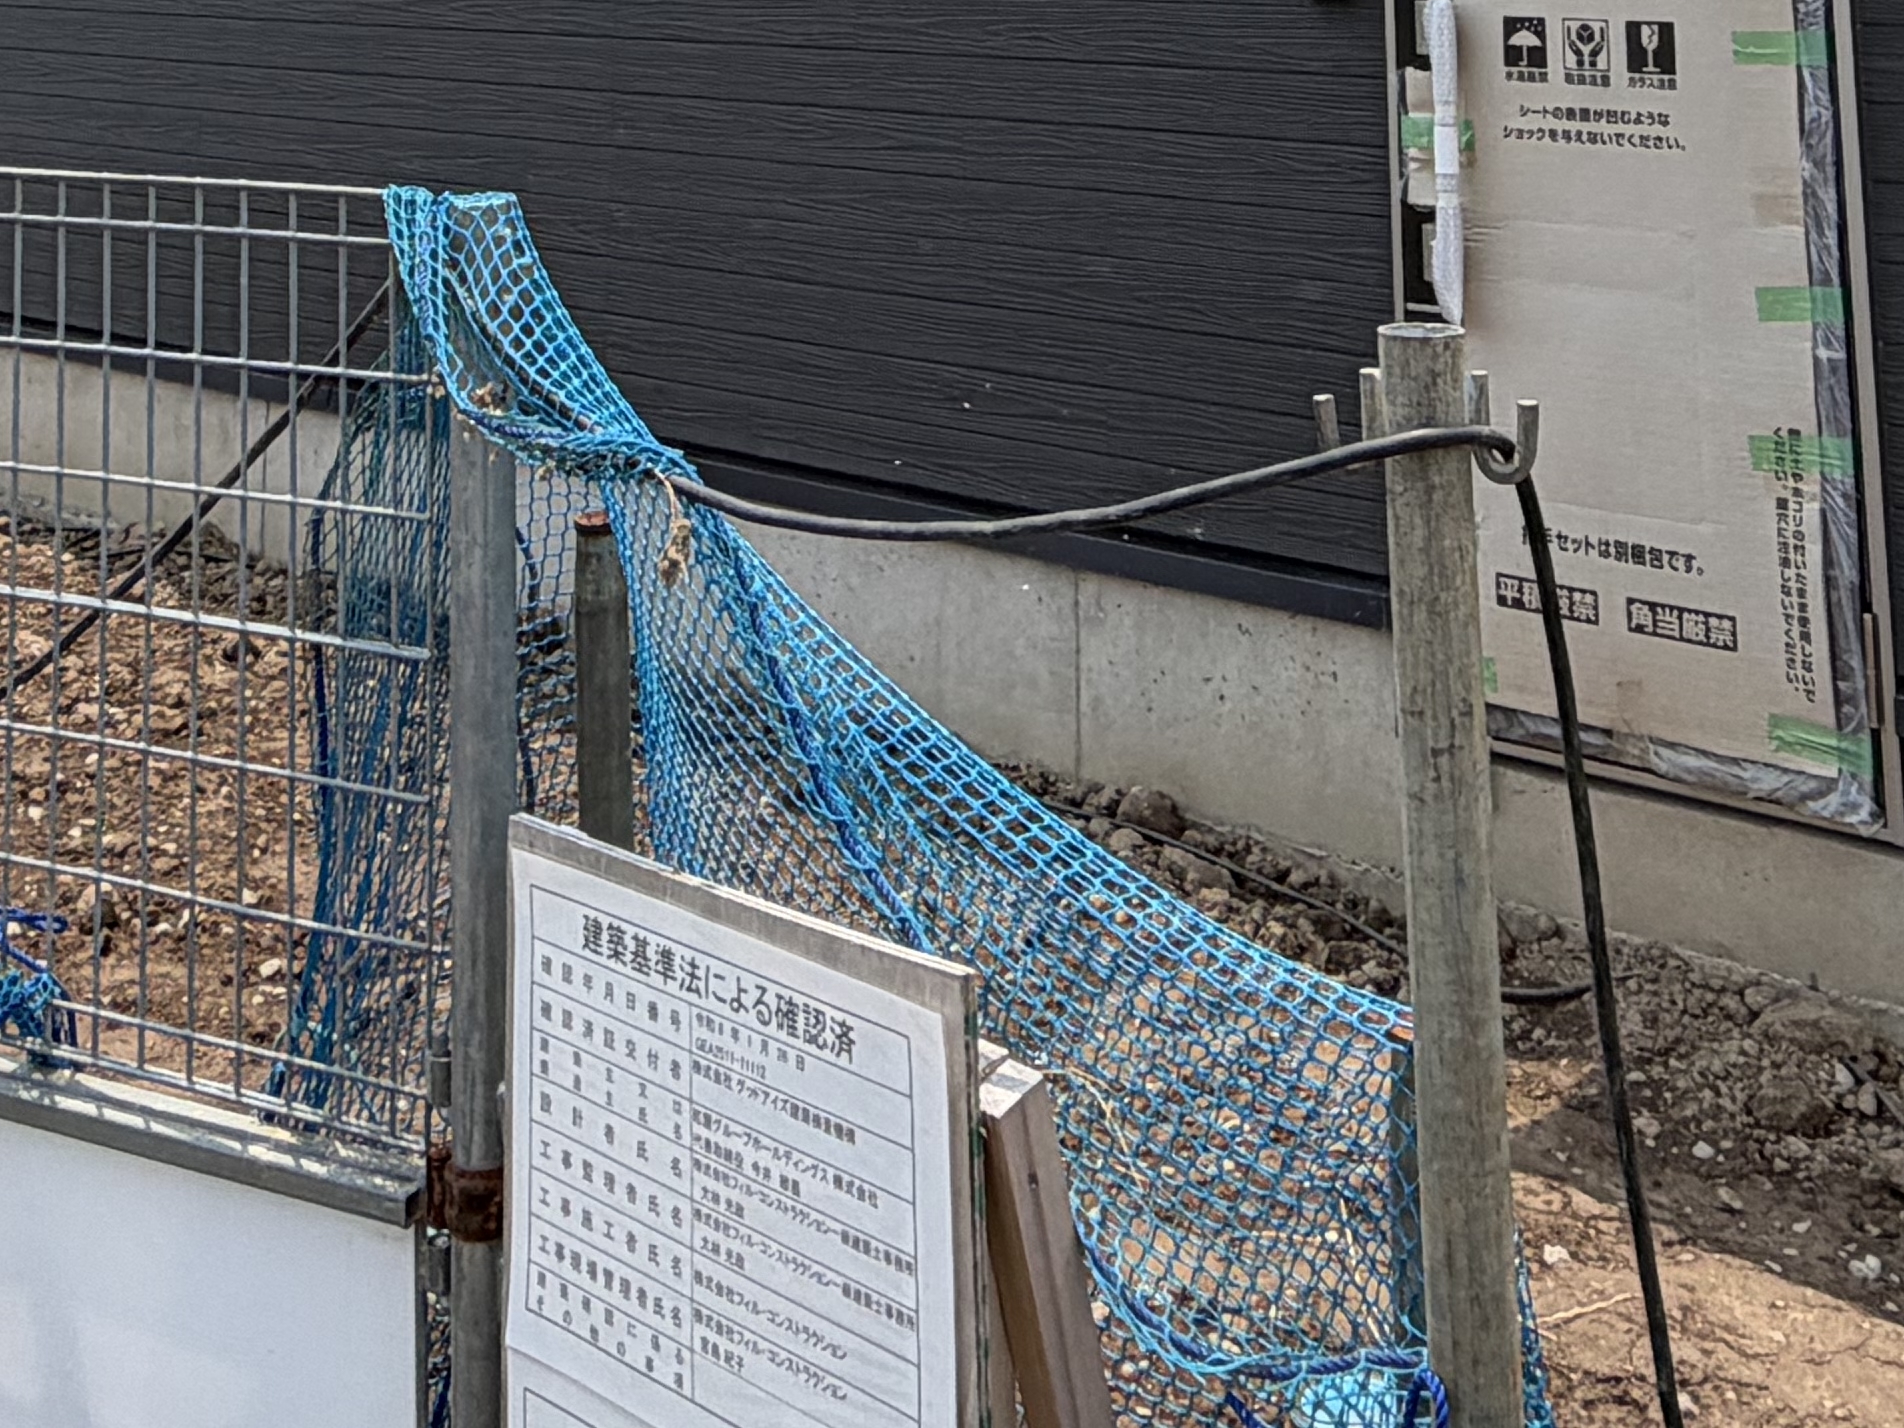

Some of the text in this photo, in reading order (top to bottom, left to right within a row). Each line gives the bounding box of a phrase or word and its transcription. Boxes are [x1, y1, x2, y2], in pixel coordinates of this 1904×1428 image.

[1520, 105, 1670, 127] シートの表面が凹むような
[1503, 126, 1685, 151] ショックを与えないでください。
[1629, 602, 1734, 649] 角当厳禁
[582, 914, 856, 1064] 建築基準法による確認済
[833, 1173, 878, 1209] 株式会社
